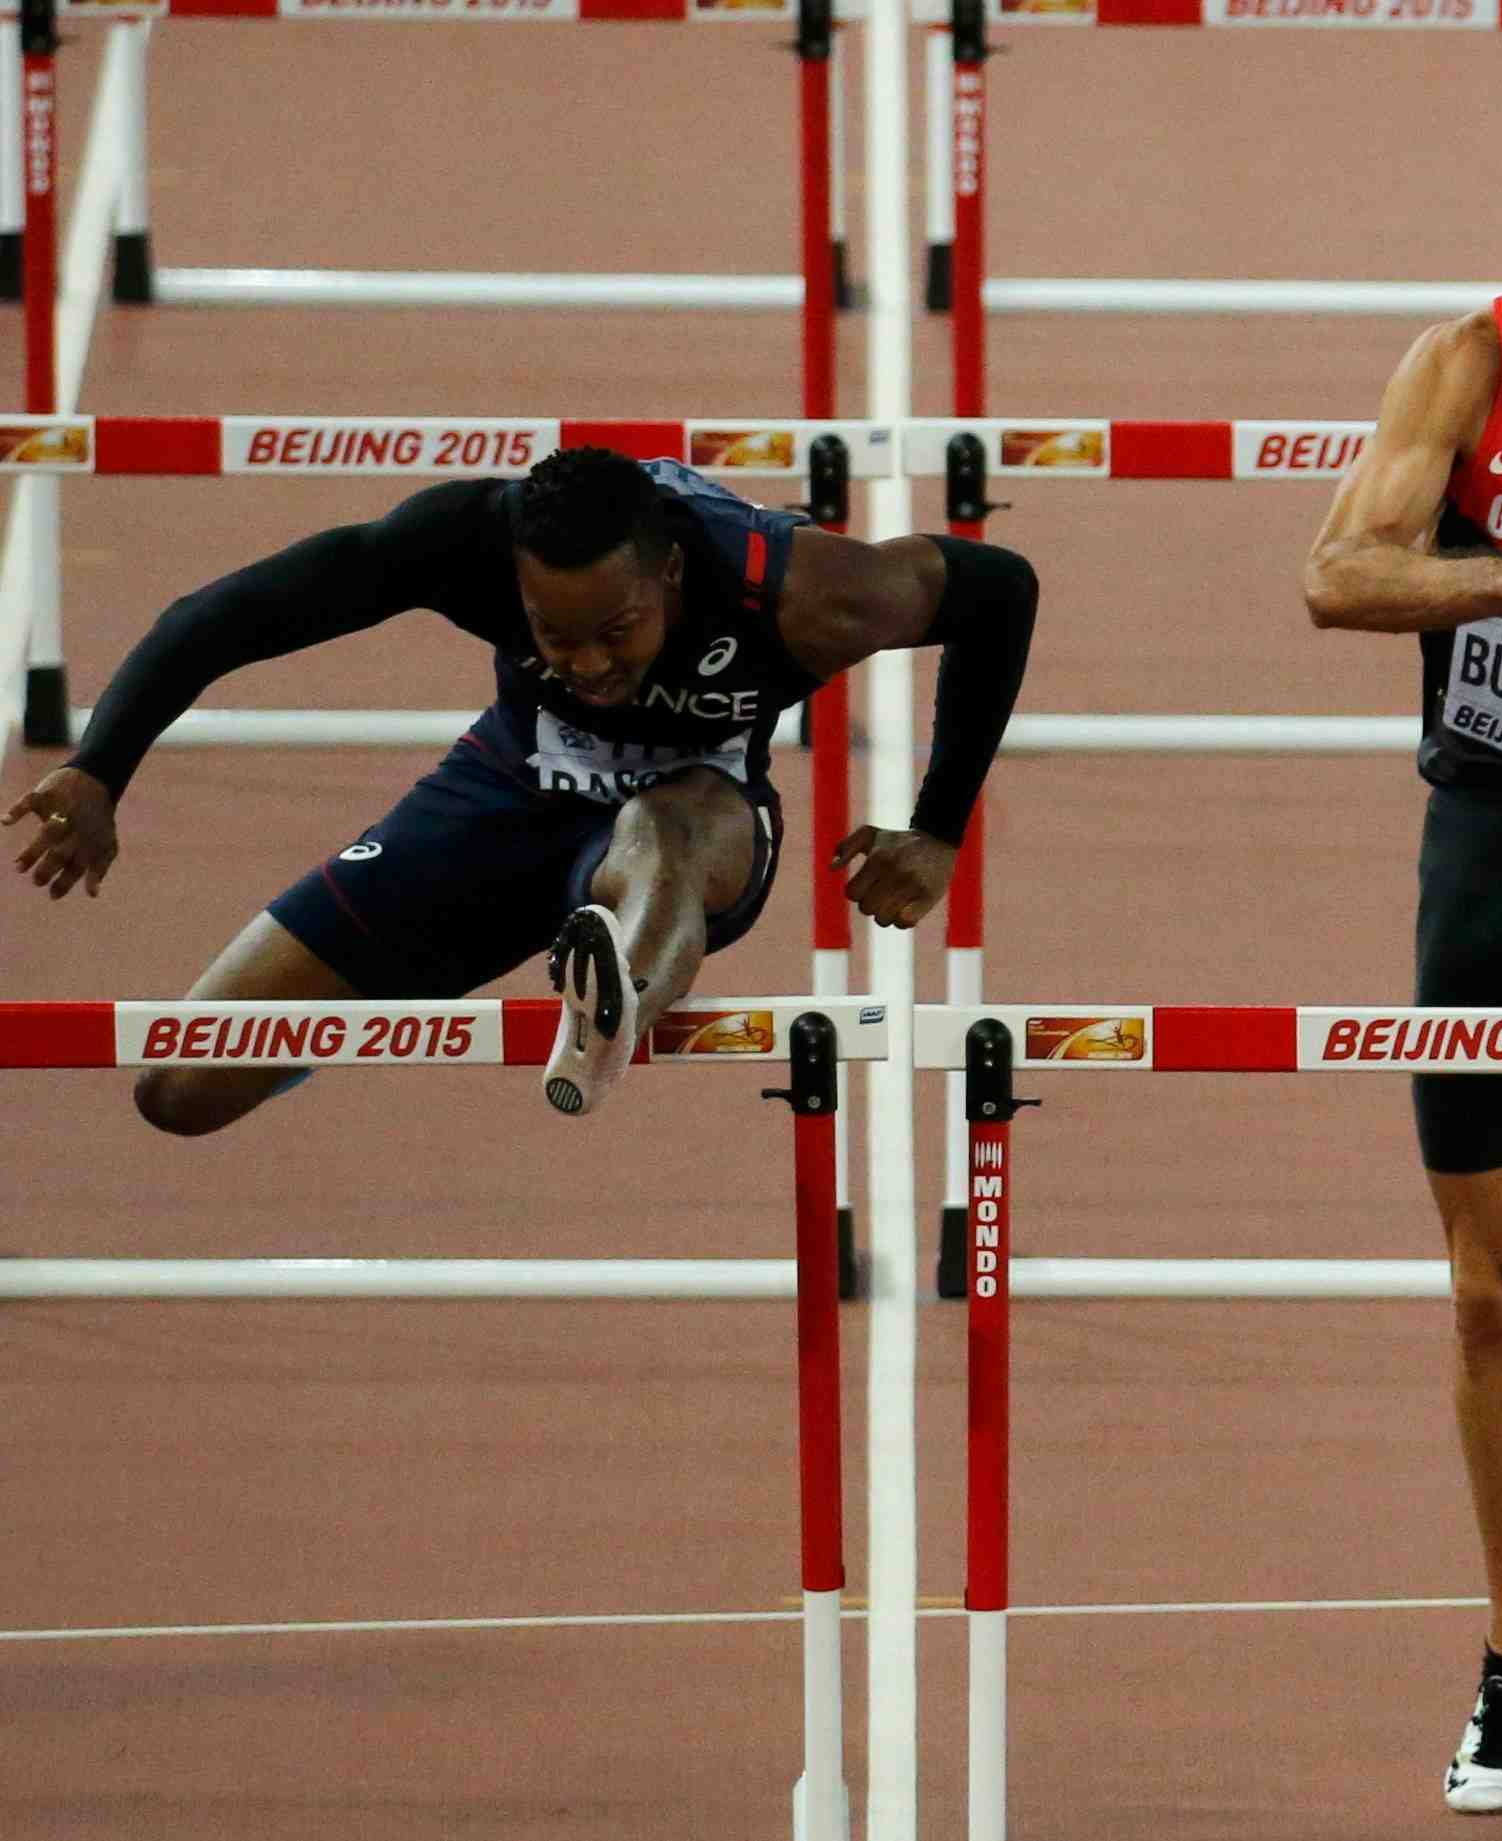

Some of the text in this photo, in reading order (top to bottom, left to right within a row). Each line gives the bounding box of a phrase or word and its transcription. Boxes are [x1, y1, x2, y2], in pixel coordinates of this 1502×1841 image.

[248, 430, 535, 466] BEIJING 2015
[1256, 433, 1365, 469] BEIJI
[142, 1016, 477, 1059] BEIJING 2015
[974, 1175, 1003, 1298] MONDO
